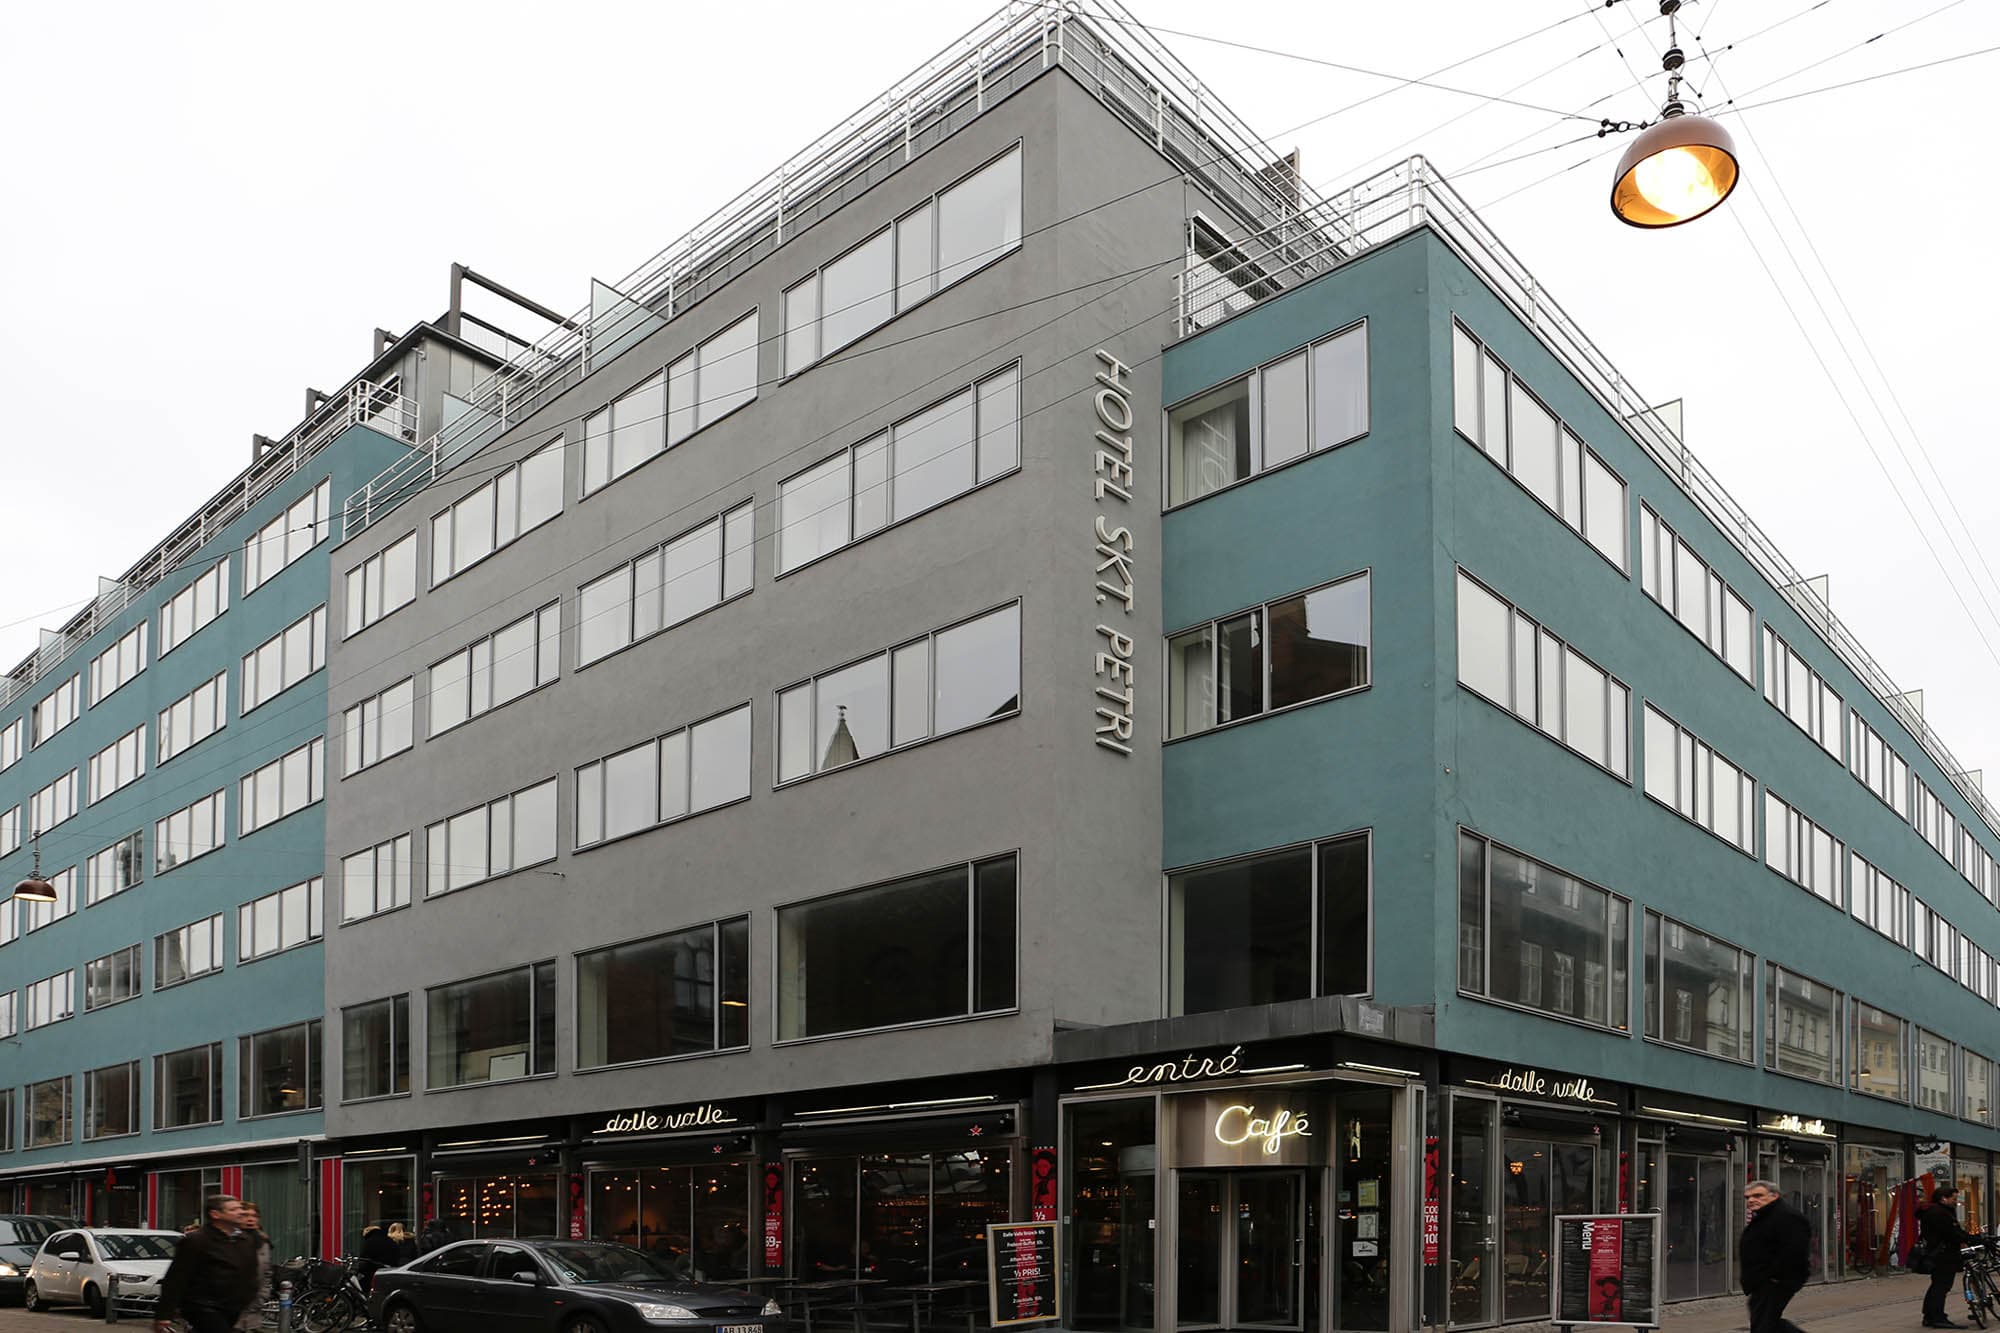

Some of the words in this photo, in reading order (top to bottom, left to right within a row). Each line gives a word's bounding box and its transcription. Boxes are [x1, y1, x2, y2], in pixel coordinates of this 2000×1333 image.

[1095, 349, 1133, 502] HOTEL
[1095, 515, 1133, 614] SKT.
[1095, 623, 1133, 757] PETRI
[1128, 1045, 1242, 1084] entré
[1500, 1068, 1546, 1095] dalle
[1551, 1078, 1596, 1102] valle
[604, 1110, 660, 1132] dalle
[663, 1104, 727, 1129] valle
[1215, 1105, 1313, 1155] Café
[1582, 1221, 1595, 1250] Menu
[1022, 1267, 1041, 1277] PRIS!
